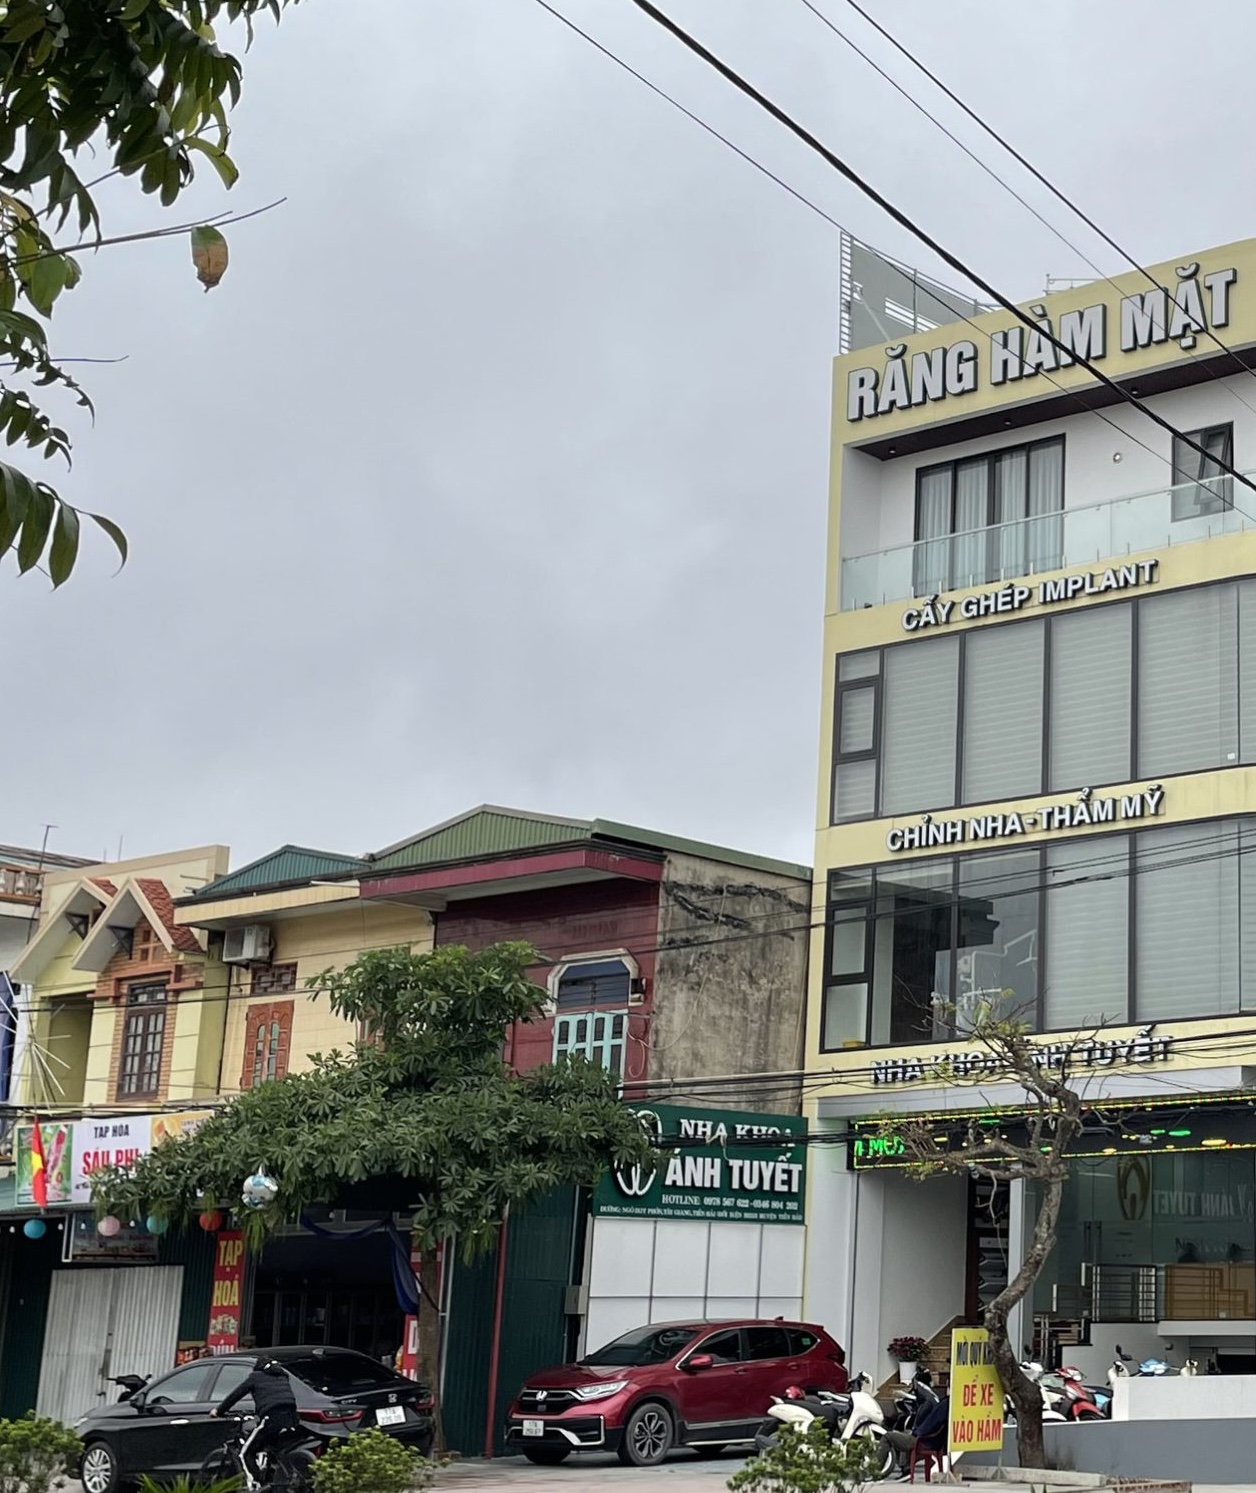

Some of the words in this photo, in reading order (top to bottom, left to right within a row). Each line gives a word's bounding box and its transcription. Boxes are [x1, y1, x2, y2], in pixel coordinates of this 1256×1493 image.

[847, 344, 978, 422] RĂNG
[990, 304, 1106, 386] HÀM
[1120, 262, 1237, 352] MẶT
[901, 595, 955, 632] CẤY
[960, 583, 1032, 619] GHÉP
[1039, 558, 1160, 604] IMPLANT
[886, 813, 965, 851] CHỈNH
[1120, 784, 1166, 819] MỸ
[871, 1057, 921, 1083] NHA
[1080, 1024, 1173, 1066] TUYẾT
[680, 1118, 727, 1139] NHA
[665, 1148, 721, 1188] ÁNH
[728, 1153, 803, 1192] TUYẾT
[219, 1240, 243, 1273] TẠP
[212, 1274, 239, 1307] HOÁ
[963, 1373, 977, 1407] ĐỂ
[980, 1383, 994, 1406] XE
[953, 1415, 974, 1444] VÀO
[977, 1410, 1001, 1442] HẦM
